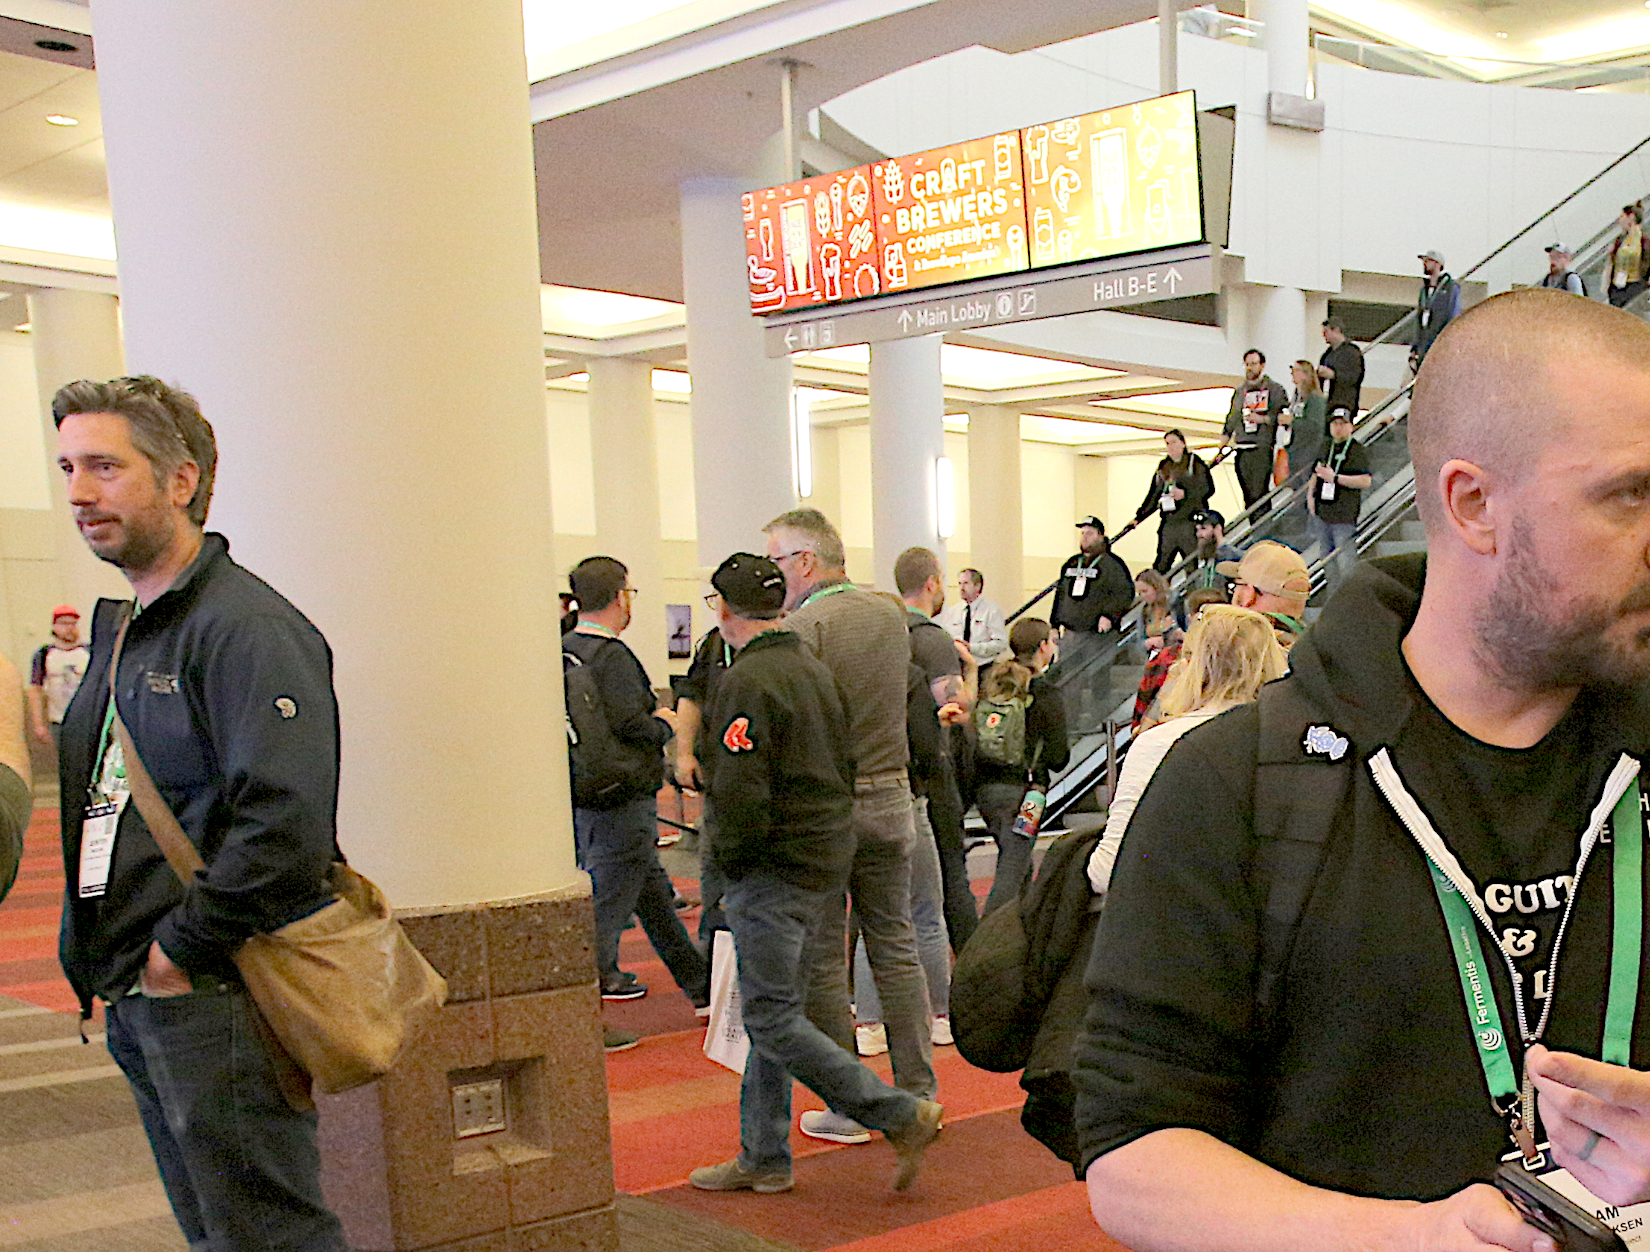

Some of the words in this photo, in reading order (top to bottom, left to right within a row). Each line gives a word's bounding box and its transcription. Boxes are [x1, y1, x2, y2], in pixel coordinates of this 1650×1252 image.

[910, 158, 986, 199] CRAFT
[896, 187, 1008, 235] BREWERS
[906, 221, 1001, 254] CONFERENCE
[1094, 280, 1124, 301] Hall
[1128, 272, 1157, 297] B-E
[917, 308, 947, 327] Main
[952, 299, 991, 324] Lobby
[1500, 928, 1537, 957] &
[1464, 960, 1491, 1026] Fermentis
